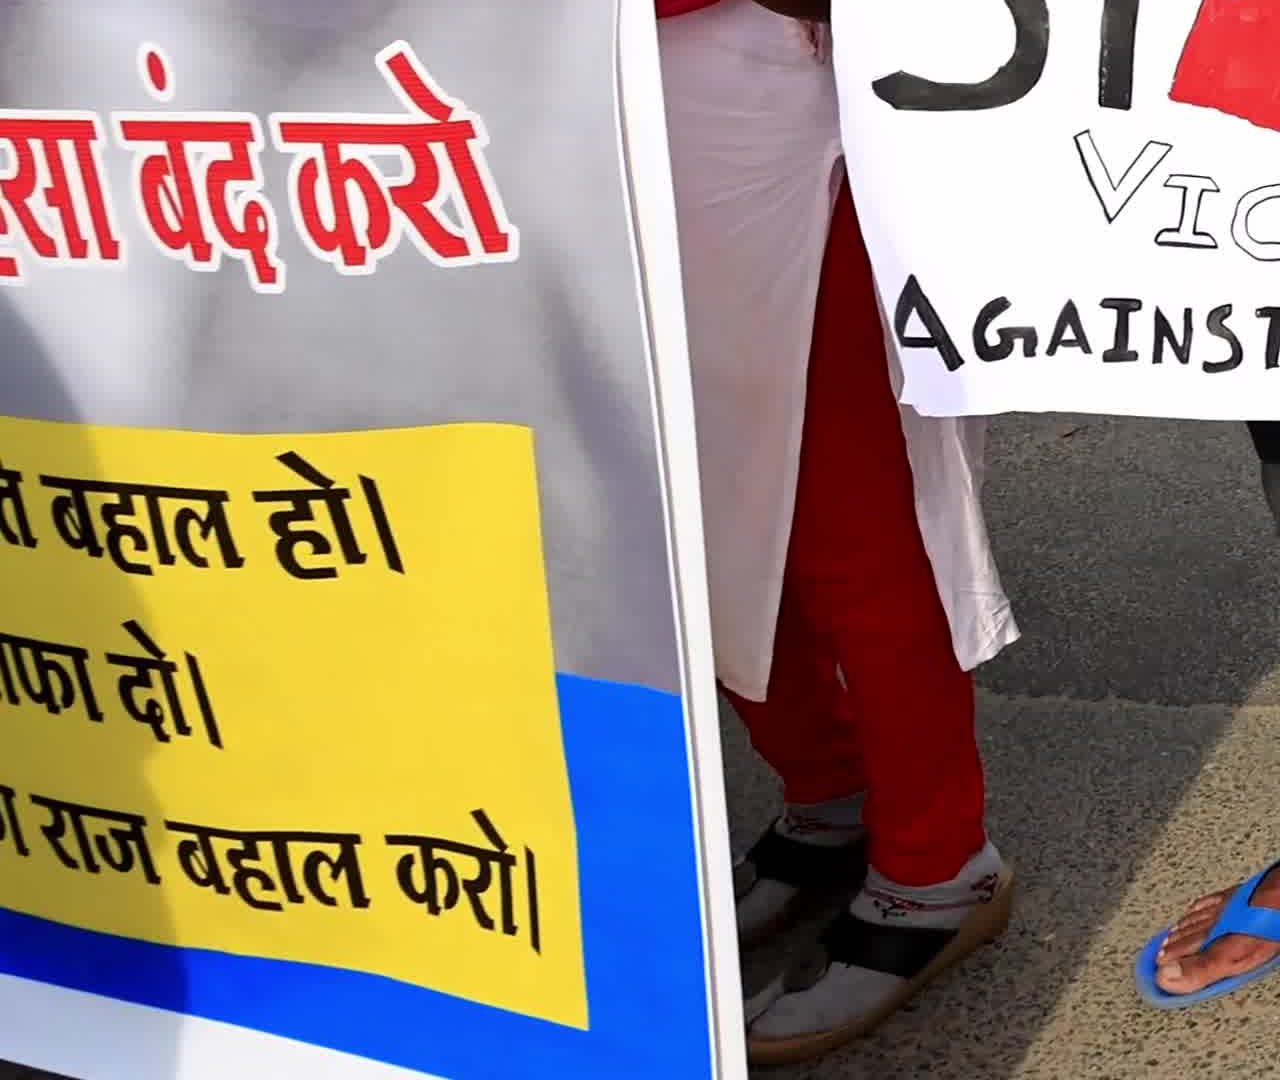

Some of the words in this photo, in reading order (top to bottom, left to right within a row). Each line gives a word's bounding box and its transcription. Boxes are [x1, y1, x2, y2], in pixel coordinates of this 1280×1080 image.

[122, 50, 276, 283] बंद
[280, 51, 509, 266] करो
[39, 474, 244, 576] बहाल
[252, 451, 405, 580] हो।
[105, 619, 223, 749] दो।
[29, 793, 161, 885] राज
[164, 820, 371, 911] बहाल
[384, 808, 541, 955] करो।
